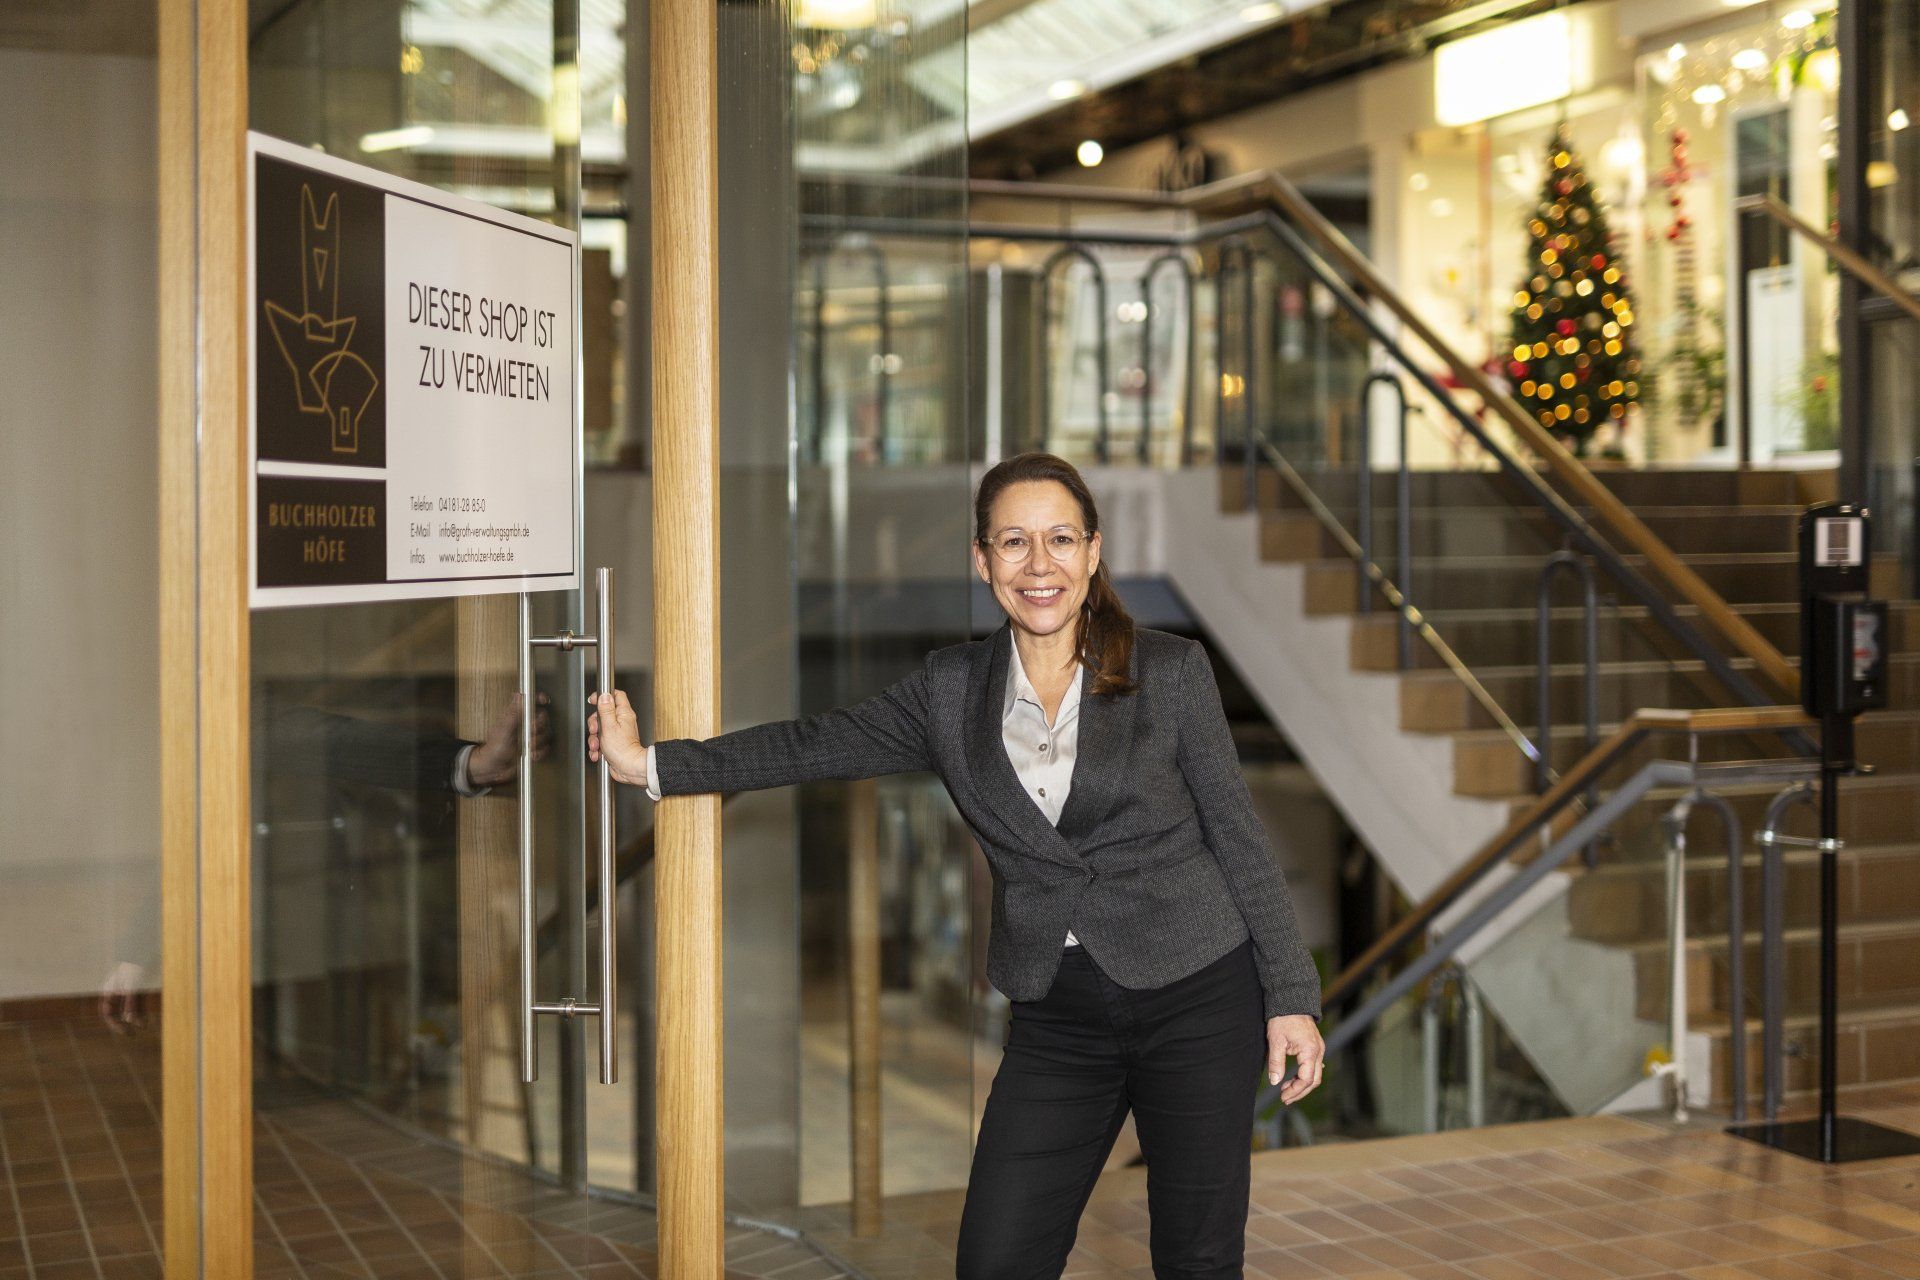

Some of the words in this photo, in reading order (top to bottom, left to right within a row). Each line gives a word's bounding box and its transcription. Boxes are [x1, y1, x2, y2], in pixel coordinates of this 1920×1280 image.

[409, 281, 473, 334] DIESER
[479, 297, 528, 344] SHOP
[534, 309, 556, 349] IST
[419, 345, 445, 389] ZU
[452, 350, 549, 402] VERMIETEN
[269, 503, 376, 527] BUCHHOLZER
[410, 495, 433, 511] Telefon
[439, 497, 470, 512] 04181-28
[471, 498, 486, 512] 85-0
[410, 521, 431, 538] E-Mail
[303, 535, 345, 562] HÖFE
[410, 547, 426, 564] Infos
[439, 546, 514, 563] www.buchholzer-hoefe.de
